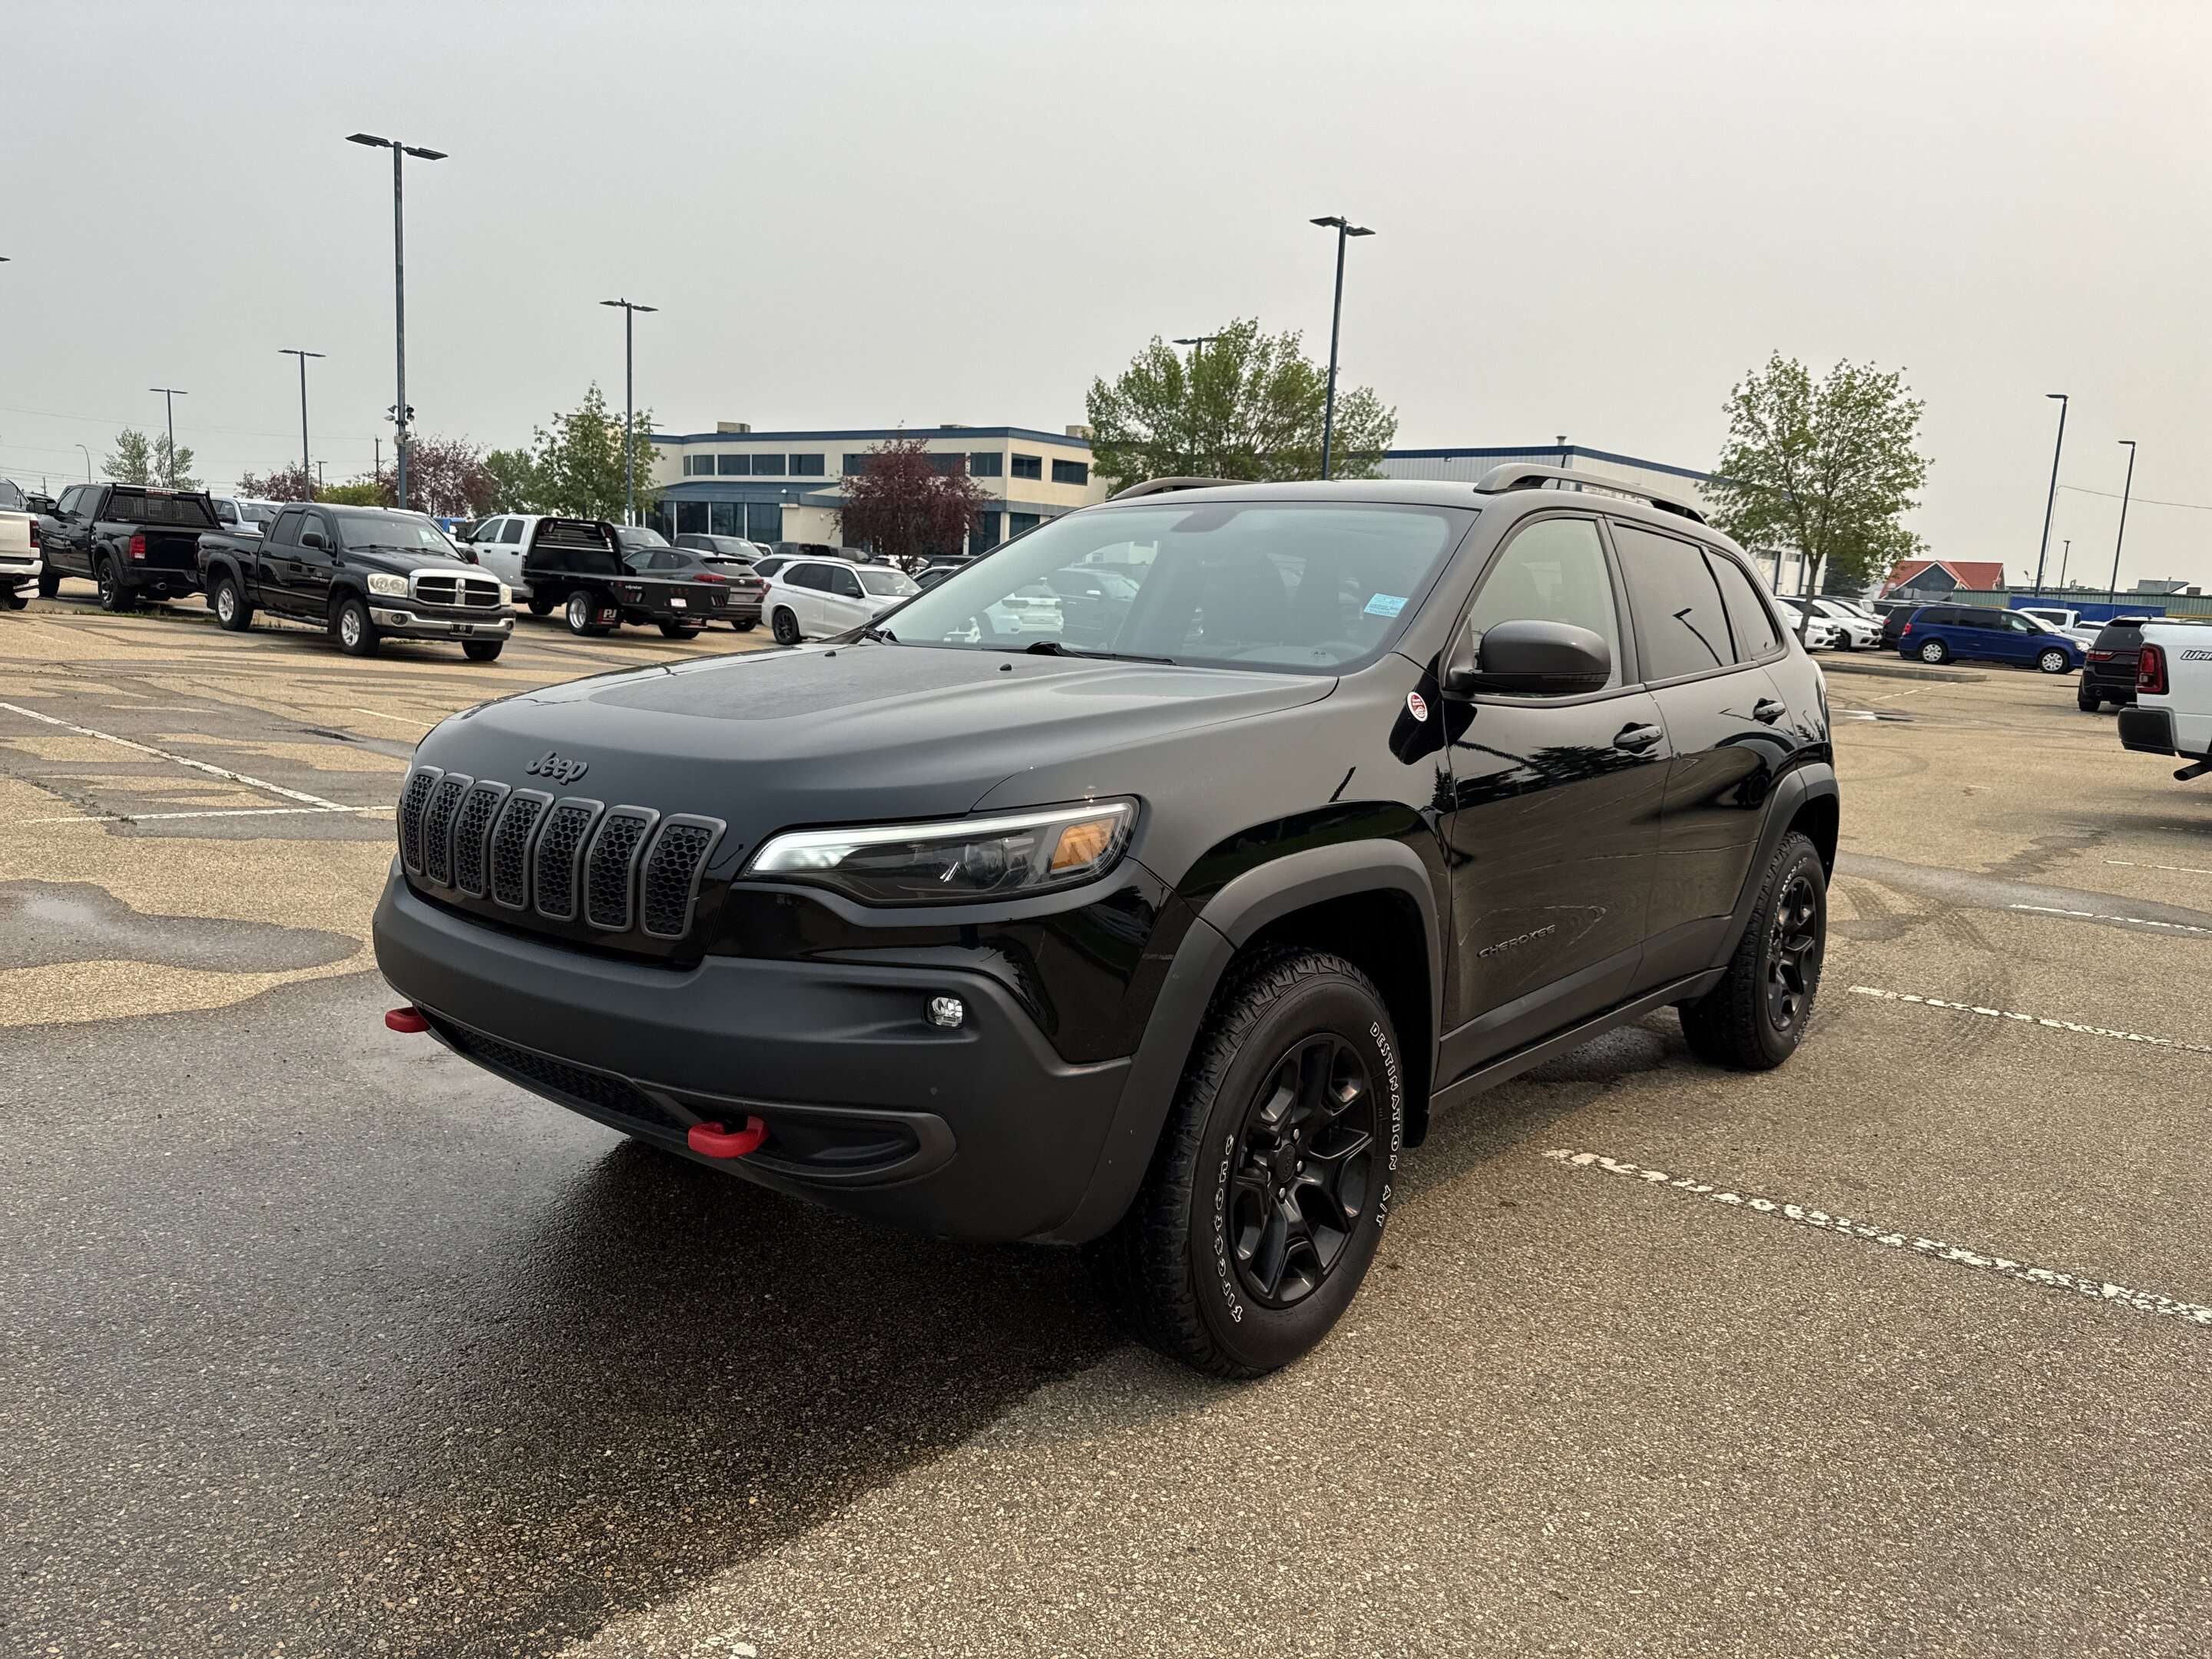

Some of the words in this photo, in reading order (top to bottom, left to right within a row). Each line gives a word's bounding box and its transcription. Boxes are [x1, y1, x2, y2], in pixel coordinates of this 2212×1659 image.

[525, 750, 589, 786] Jeep
[1477, 924, 1555, 958] CHEROKEE
[1370, 1022, 1400, 1171] DESTINATION
[1376, 1184, 1391, 1227] A/T
